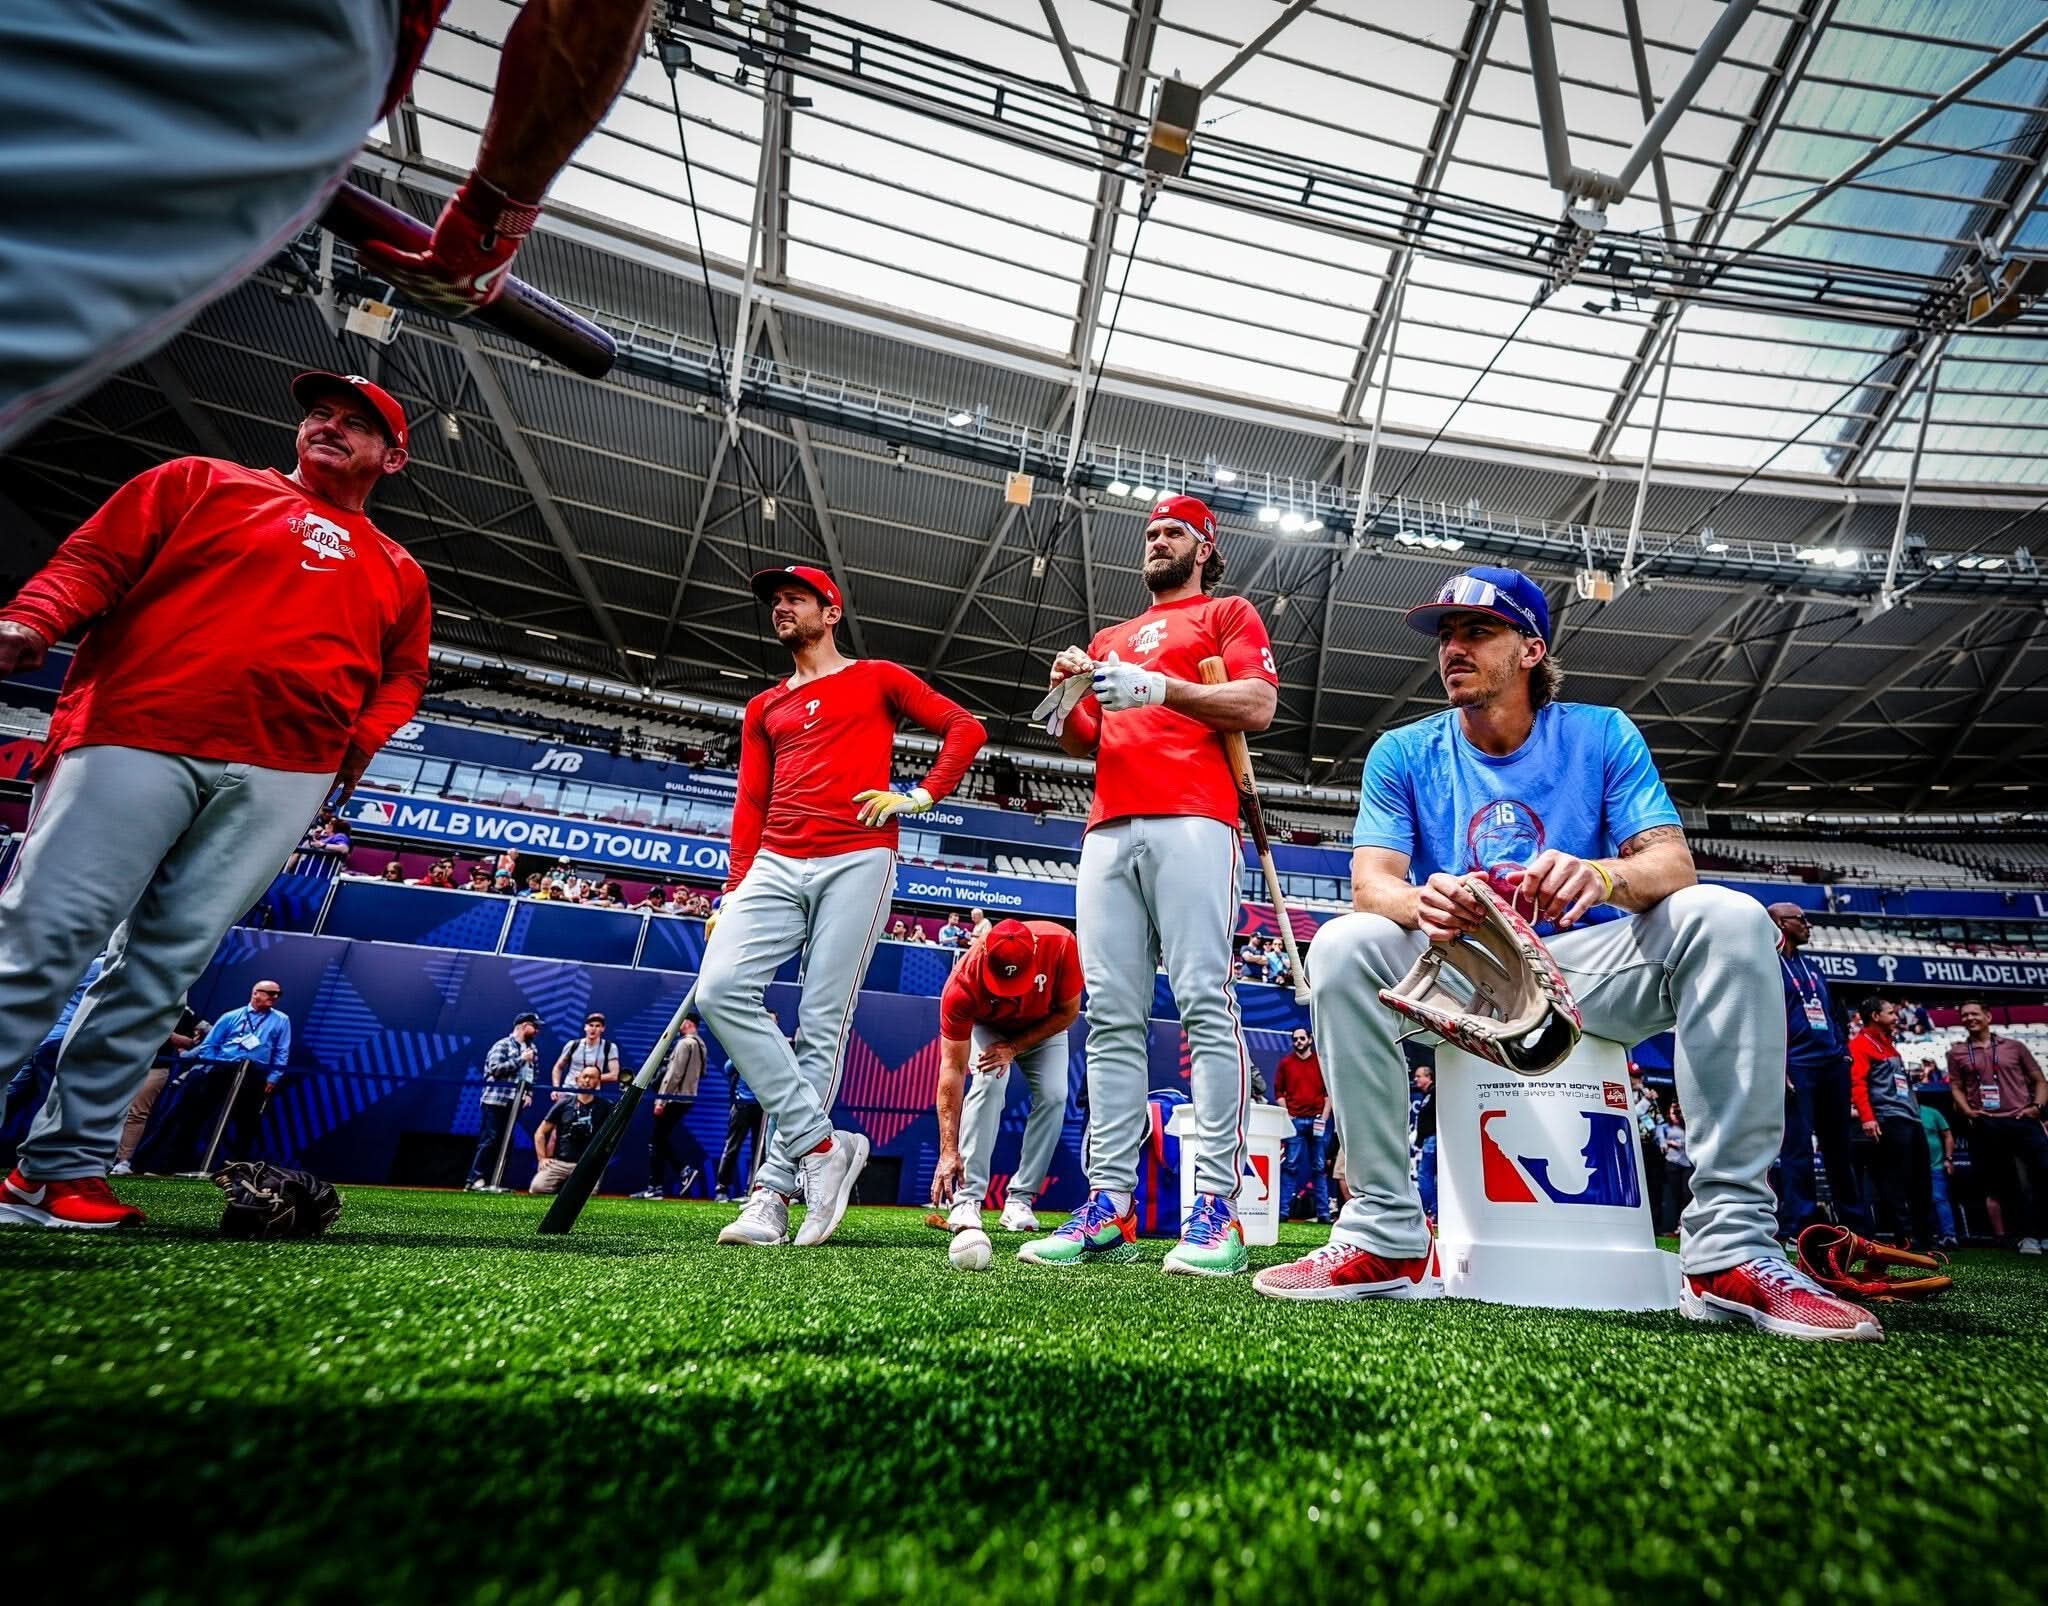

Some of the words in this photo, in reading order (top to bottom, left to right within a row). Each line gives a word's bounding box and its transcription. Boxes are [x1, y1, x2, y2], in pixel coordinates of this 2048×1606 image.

[805, 699, 821, 717] P
[391, 722, 425, 741] B
[531, 748, 584, 773] JTB
[1008, 796, 1027, 808] 207
[1494, 803, 1516, 825] 16
[397, 805, 471, 836] MLB
[475, 815, 590, 851] WORLD
[591, 832, 671, 864] TOUR
[945, 876, 979, 886] Presented
[979, 879, 988, 888] by
[908, 882, 952, 898] zoom
[955, 887, 1022, 906] Workplace
[1804, 955, 1858, 977] RIES
[1034, 973, 1048, 993] P
[1477, 1081, 1525, 1090] BASEBALL
[1528, 1081, 1567, 1089] LEAGUE
[1569, 1083, 1600, 1091] MAJOR
